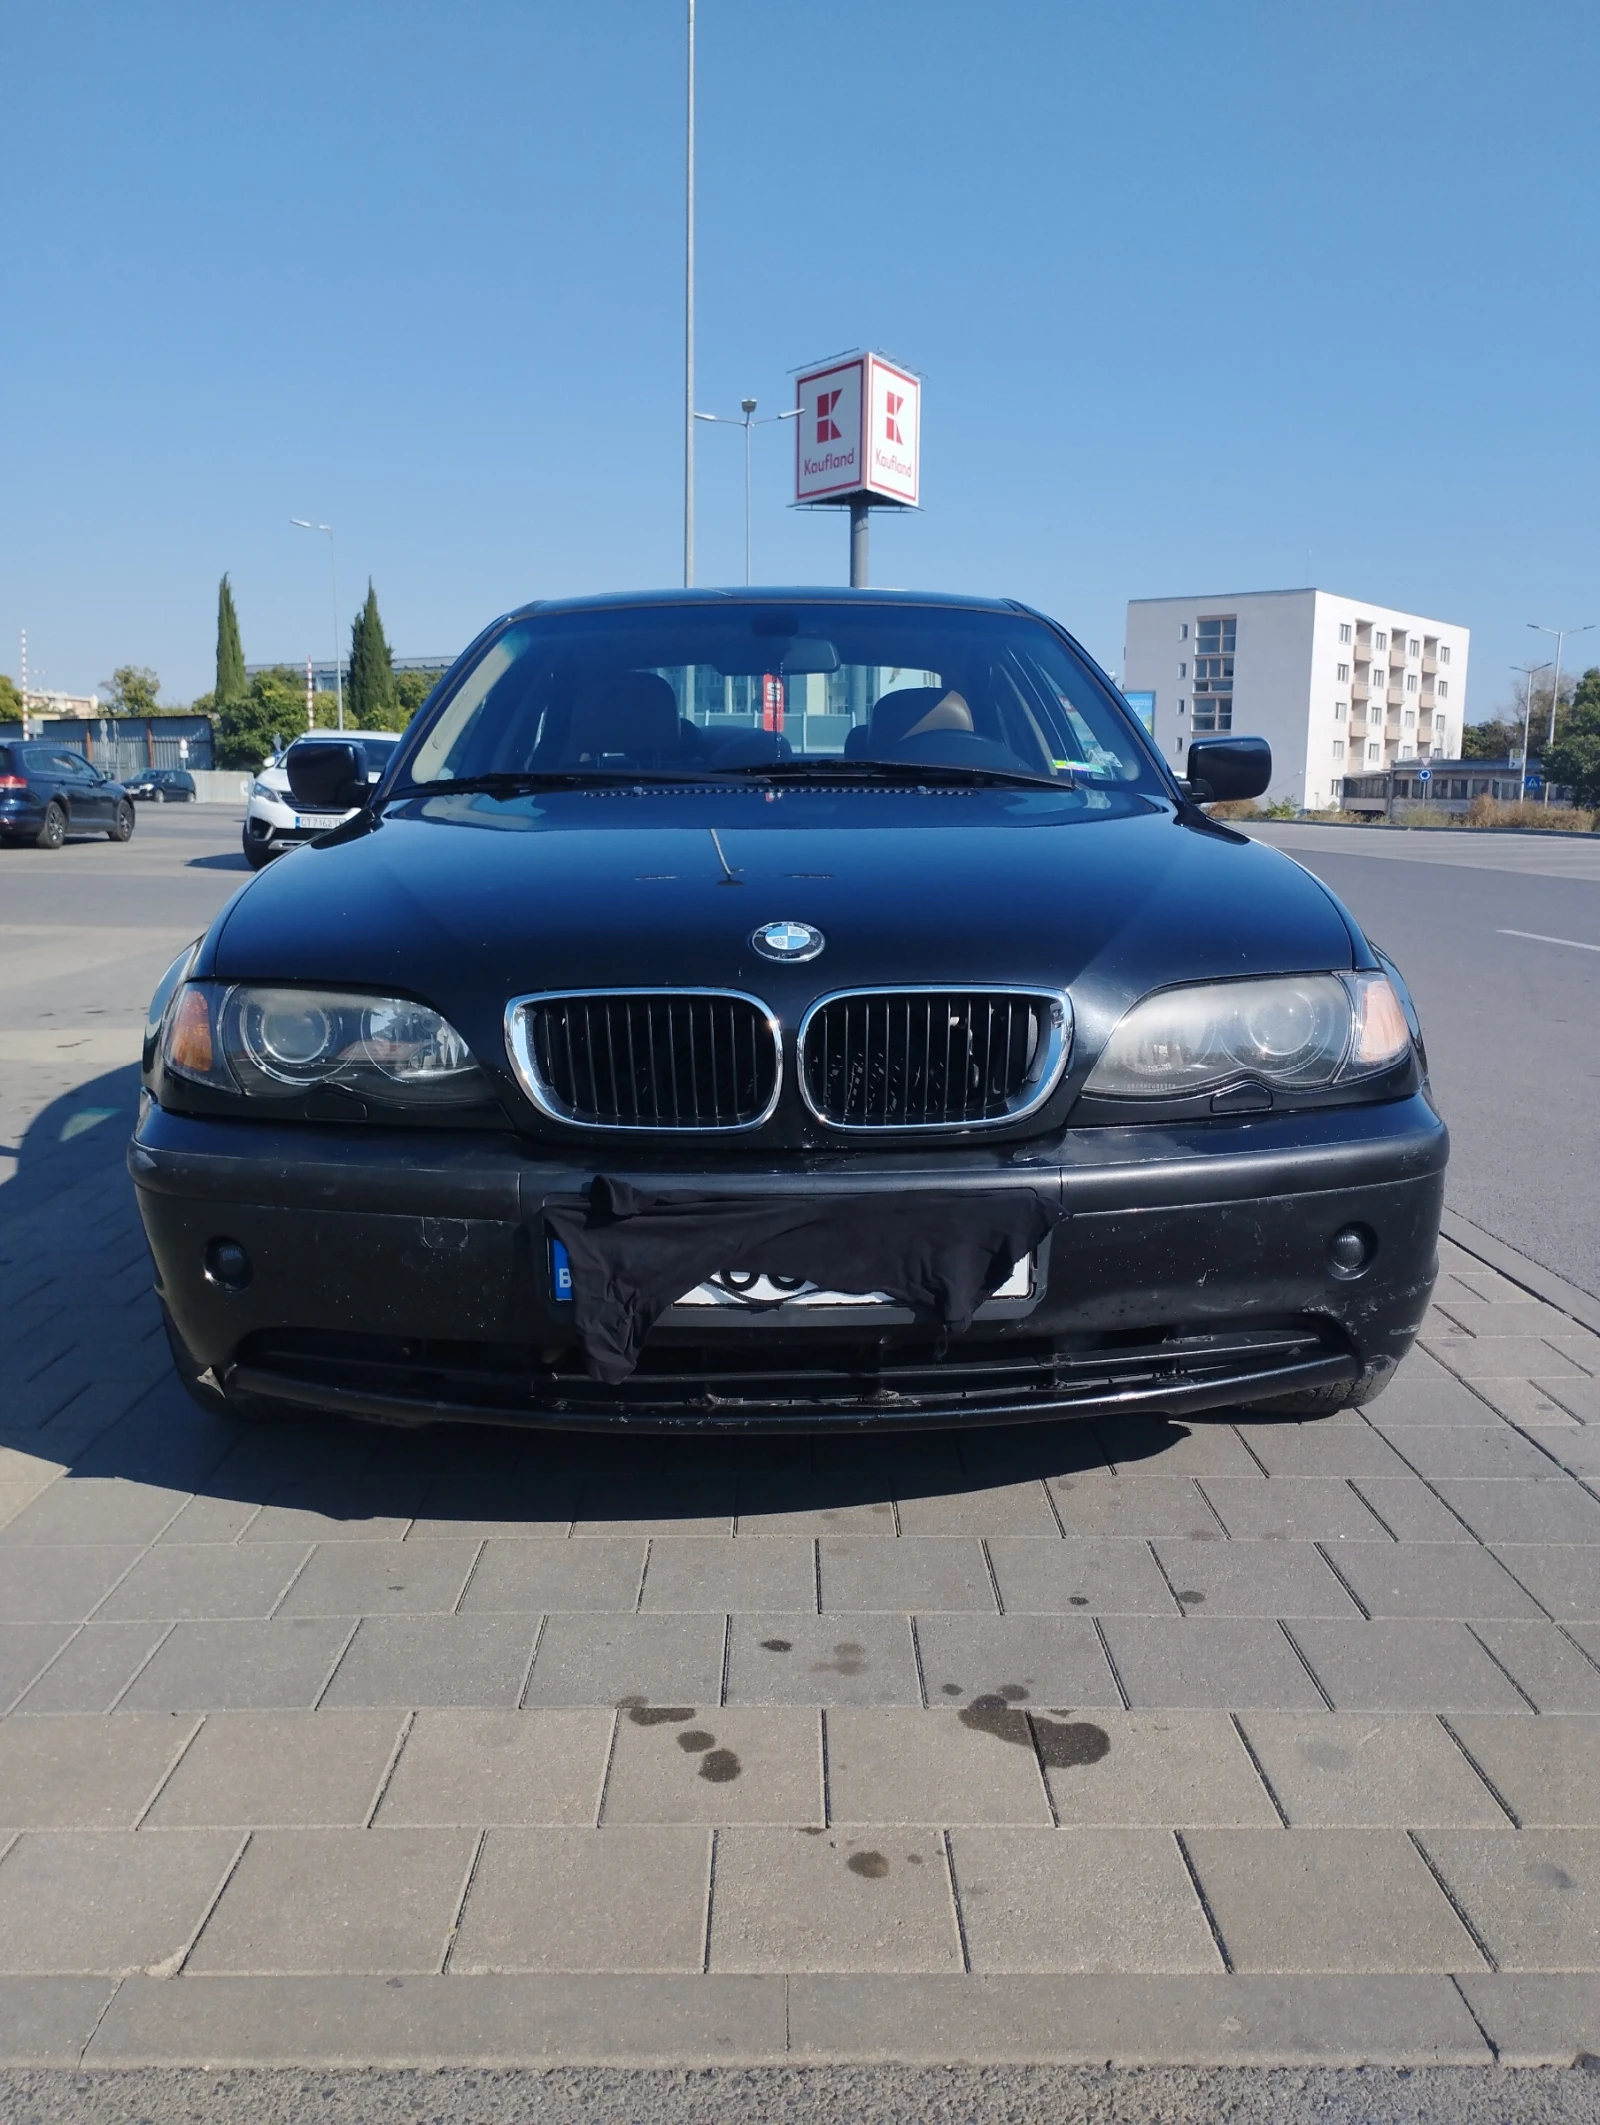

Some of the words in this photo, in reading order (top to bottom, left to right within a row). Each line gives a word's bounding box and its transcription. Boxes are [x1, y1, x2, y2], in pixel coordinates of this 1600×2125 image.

[817, 388, 843, 444] K
[886, 390, 904, 446] K
[804, 448, 855, 476] Kaufland
[876, 449, 912, 478] Kaufland
[559, 1268, 572, 1288] B
